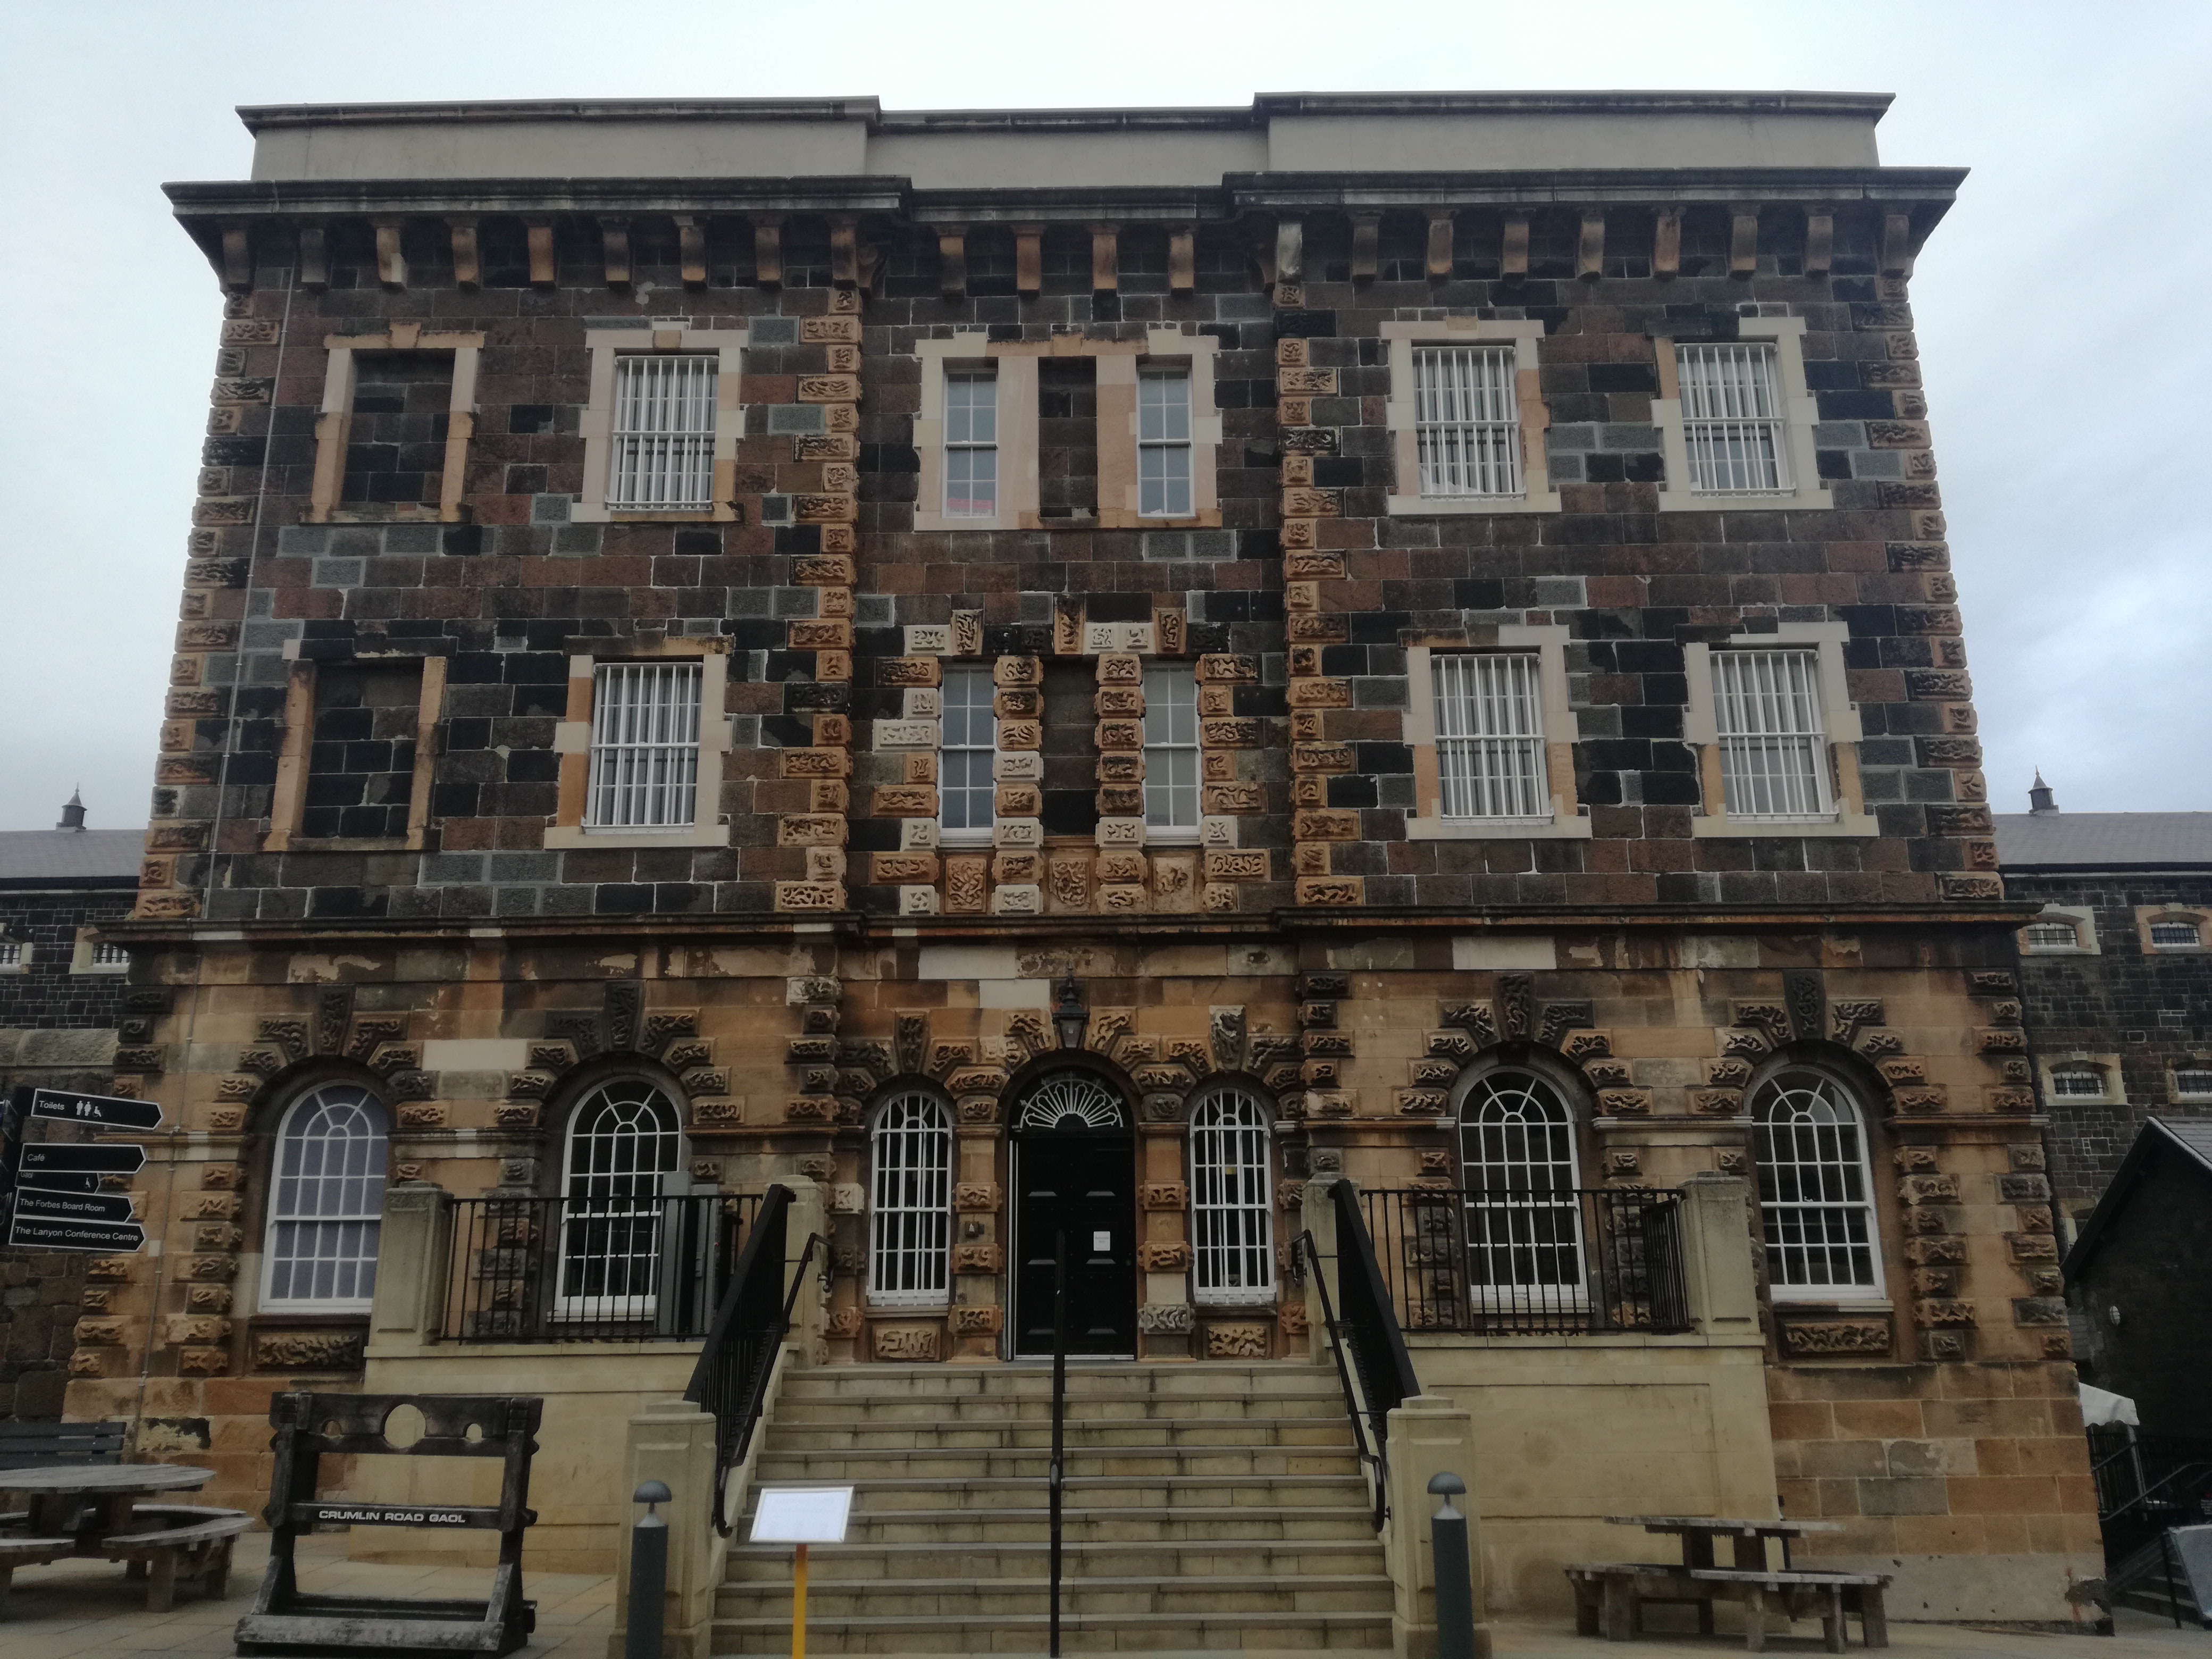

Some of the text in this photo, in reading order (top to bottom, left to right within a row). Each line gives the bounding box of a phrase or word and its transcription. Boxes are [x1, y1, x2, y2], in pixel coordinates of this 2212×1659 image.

[39, 1100, 65, 1110] Toilets
[36, 1200, 60, 1209] Forbes
[62, 1202, 83, 1210] Board
[15, 1226, 138, 1241] The Lanyon Conference Centre
[319, 1511, 466, 1523] CRUMLIN ROAD GAOL
